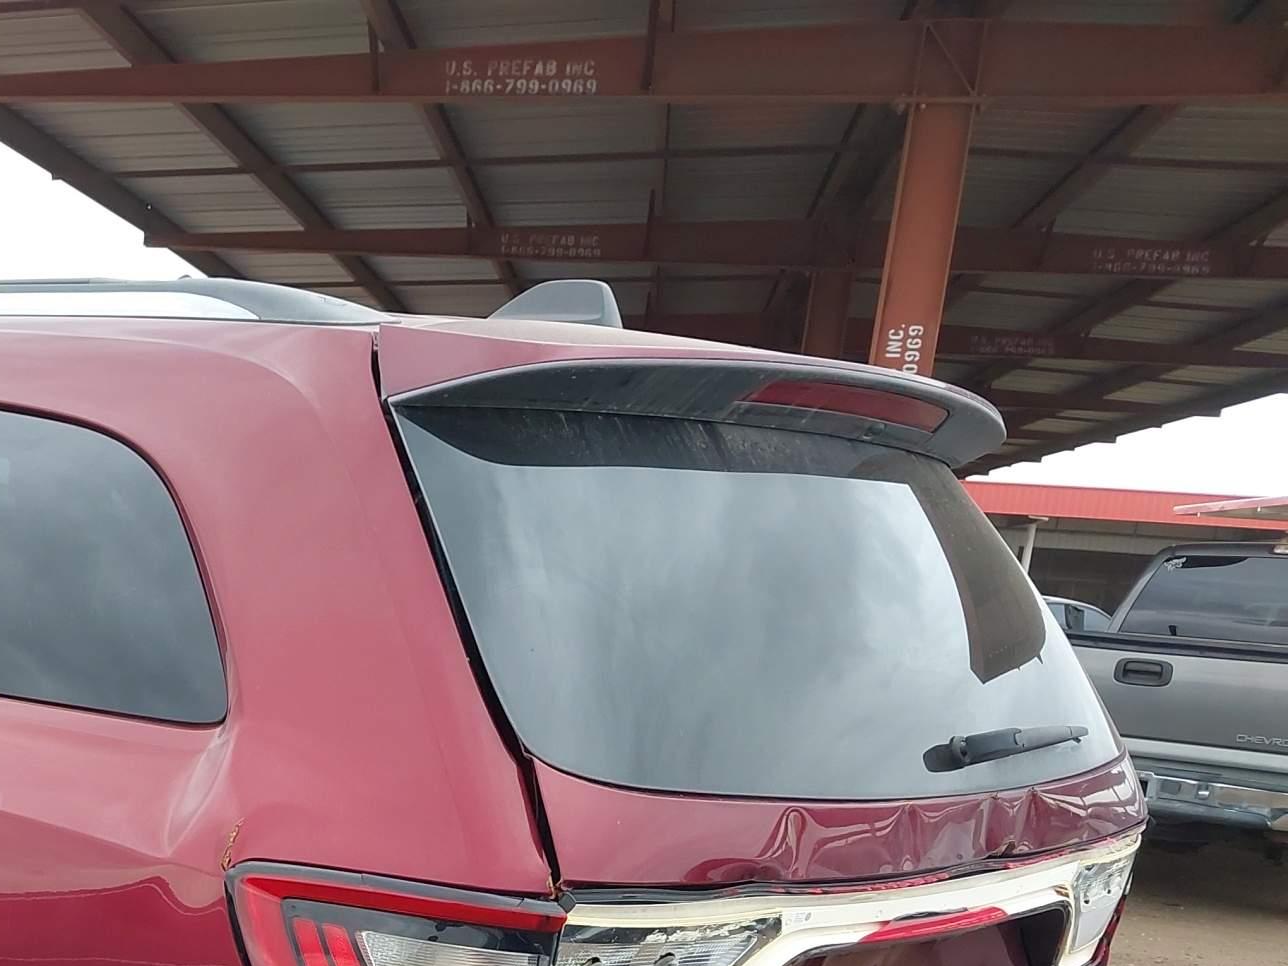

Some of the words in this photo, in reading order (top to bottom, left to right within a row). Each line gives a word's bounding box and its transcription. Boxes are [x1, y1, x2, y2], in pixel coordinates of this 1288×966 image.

[445, 60, 478, 77] U.S.
[487, 60, 558, 77] PREFAB
[565, 59, 595, 76] INC
[445, 78, 598, 95] 1-866-799-0969
[884, 323, 906, 358] INC.
